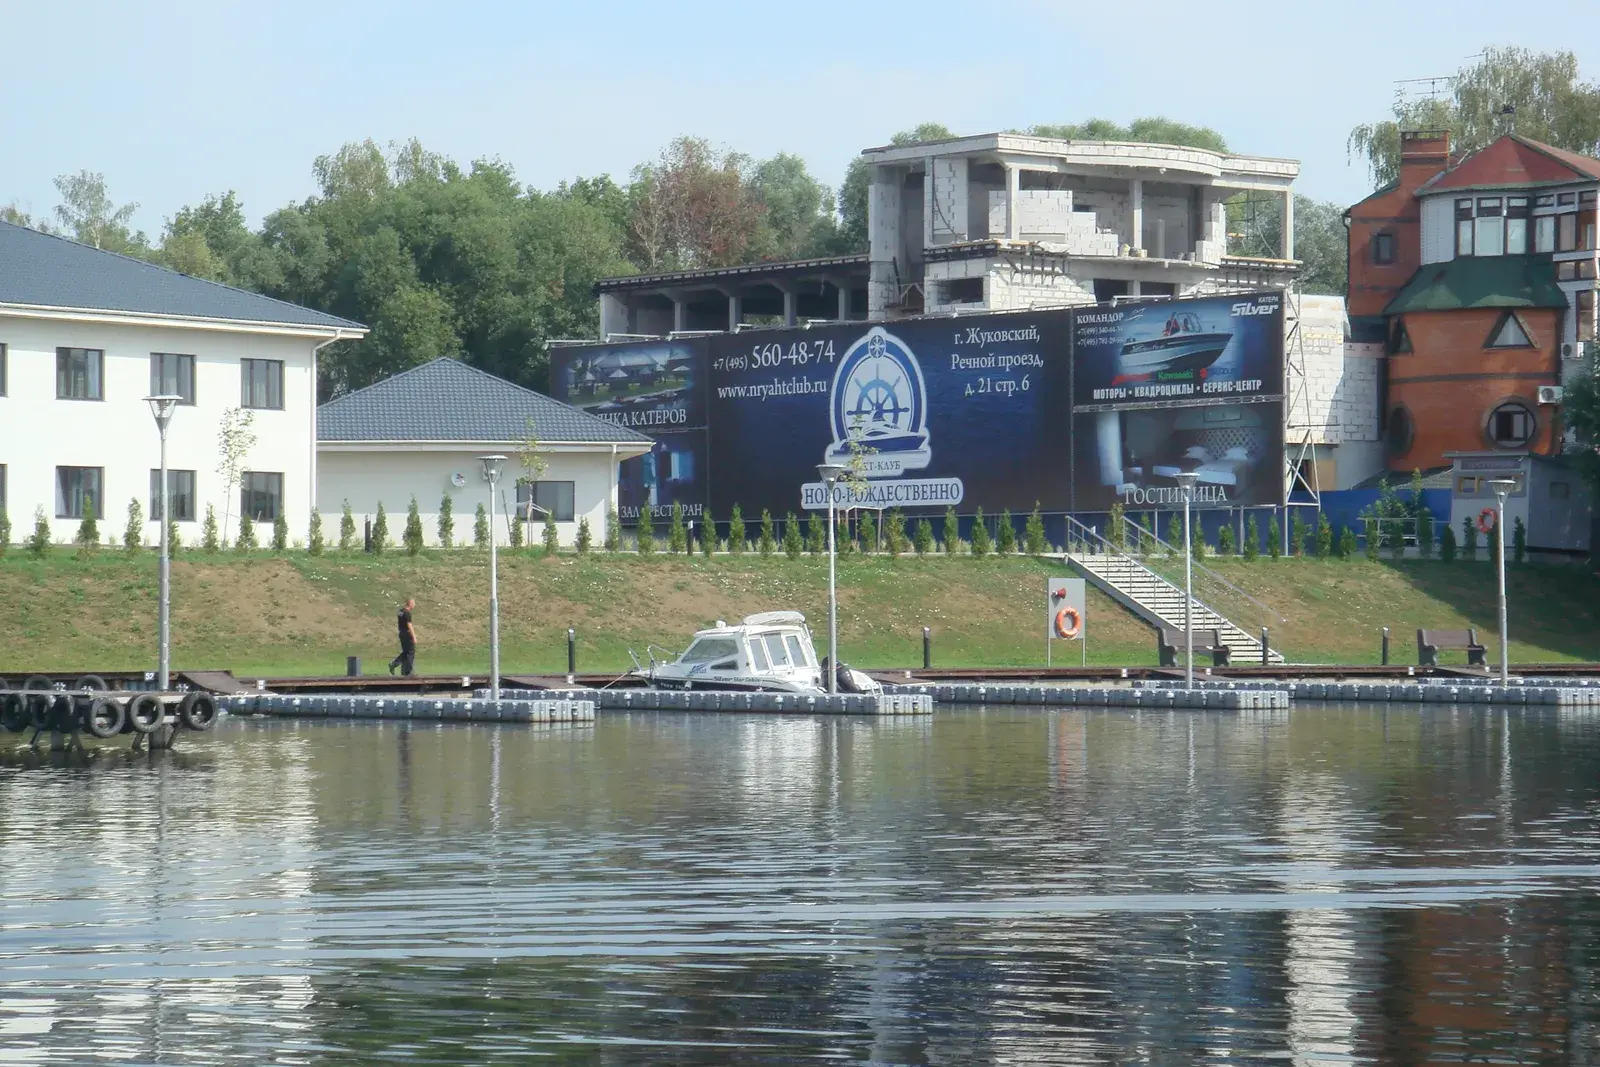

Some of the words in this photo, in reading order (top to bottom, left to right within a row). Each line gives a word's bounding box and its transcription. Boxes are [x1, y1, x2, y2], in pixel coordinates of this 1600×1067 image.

[1077, 312, 1124, 324] КОМАНДОР
[954, 333, 963, 345] г.
[965, 325, 1040, 349] Жуковский,
[713, 358, 724, 370] +7
[725, 354, 748, 372] (495)
[751, 339, 836, 369] 560-48-74
[951, 352, 996, 370] Речной
[998, 353, 1044, 372] проезд,
[717, 375, 827, 402] www.nryahtclub.ru
[965, 383, 975, 397] д.
[978, 377, 992, 393] 21
[995, 380, 1019, 397] стр.
[1022, 373, 1030, 391] 6
[1093, 387, 1127, 400] МОТОРЫ
[1134, 383, 1194, 398] КВАДРОЦИКЛЫ
[1202, 379, 1262, 394] СЕРВИС-ЦЕНТР
[597, 411, 630, 427] ЯНКА
[631, 408, 687, 426] КАТЕРОВ
[863, 460, 901, 471] ХТ-КЛУБ
[621, 505, 640, 518] ЗАЛ
[650, 503, 703, 517] РЕСТРАН
